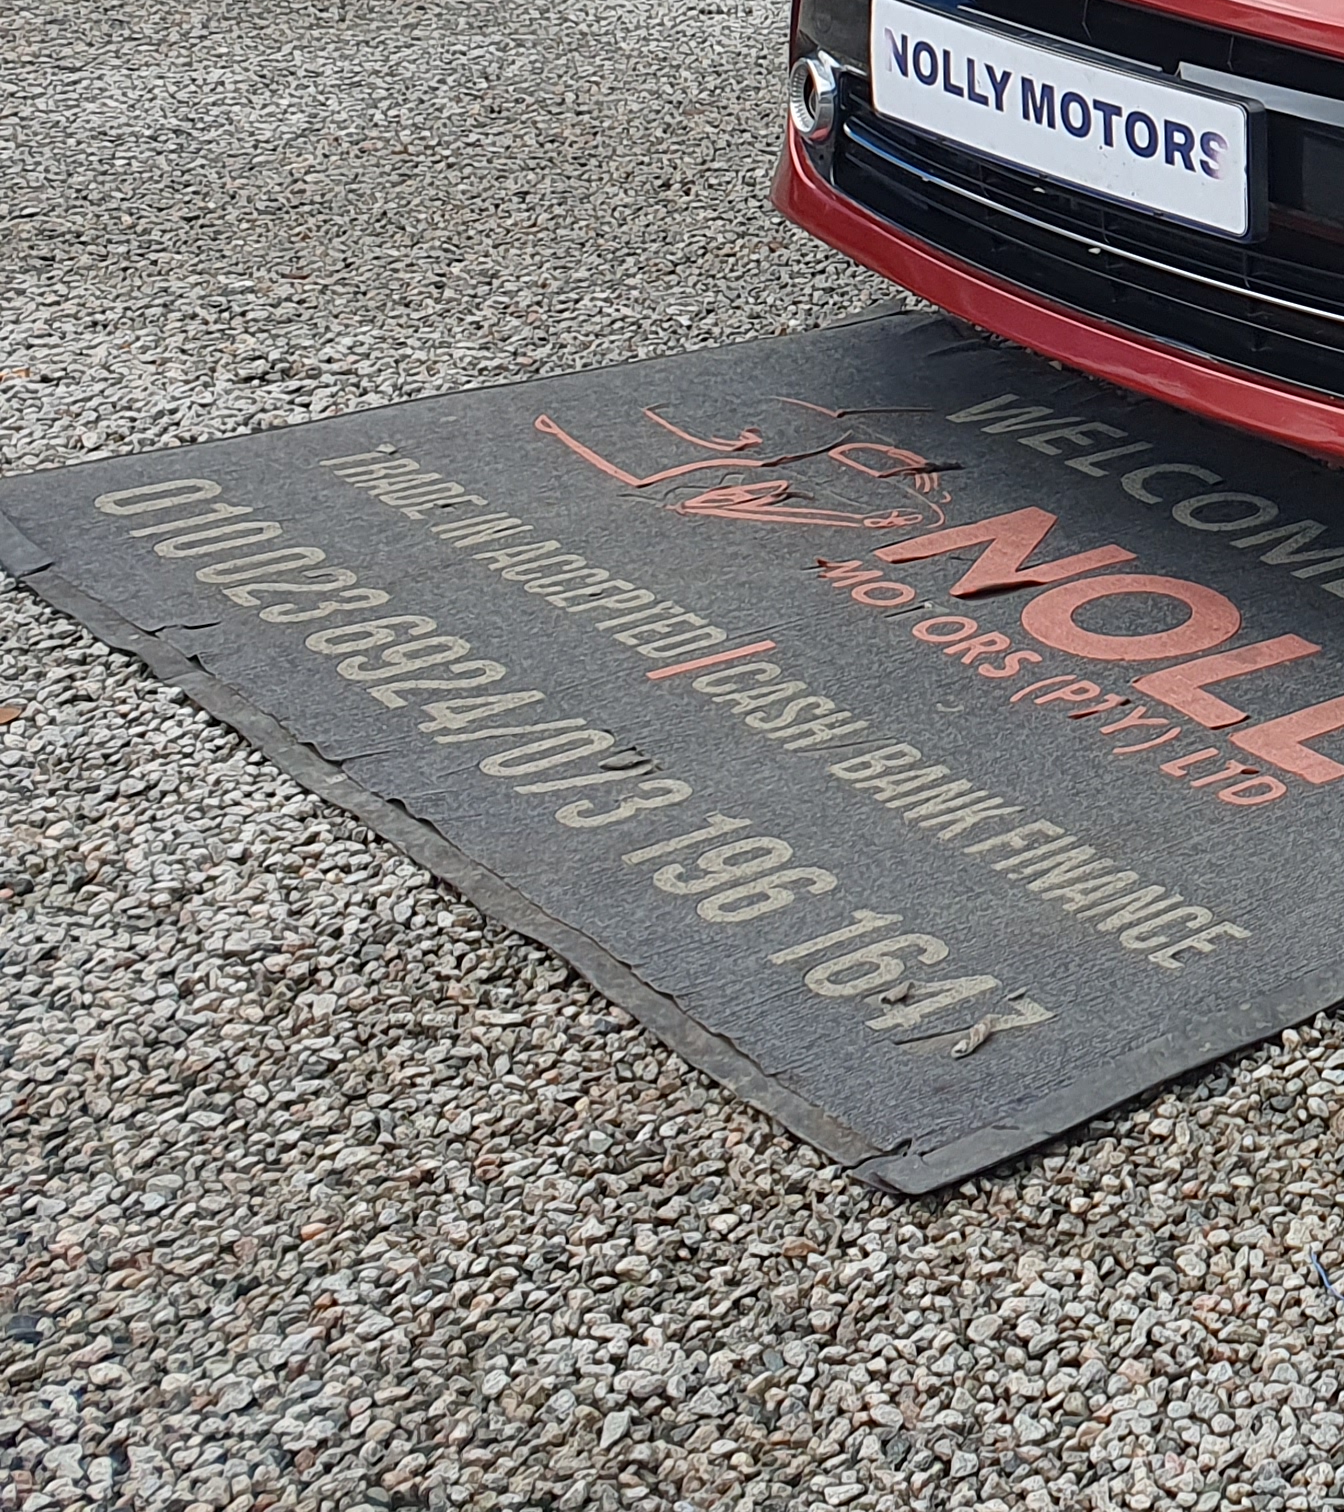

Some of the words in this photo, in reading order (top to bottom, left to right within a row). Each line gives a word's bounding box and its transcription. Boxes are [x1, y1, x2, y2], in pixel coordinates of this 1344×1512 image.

[884, 26, 1013, 114] NOLLY
[1021, 76, 1231, 180] MOTORS
[318, 448, 489, 520] TRADE
[430, 512, 534, 549] IN
[473, 540, 728, 659] ACCEPTED
[1010, 674, 1181, 755] (PTY)
[1159, 747, 1287, 807] LTD
[621, 813, 839, 924] 196
[769, 909, 1057, 1060] 1647
[963, 818, 1254, 970] FINANCE
